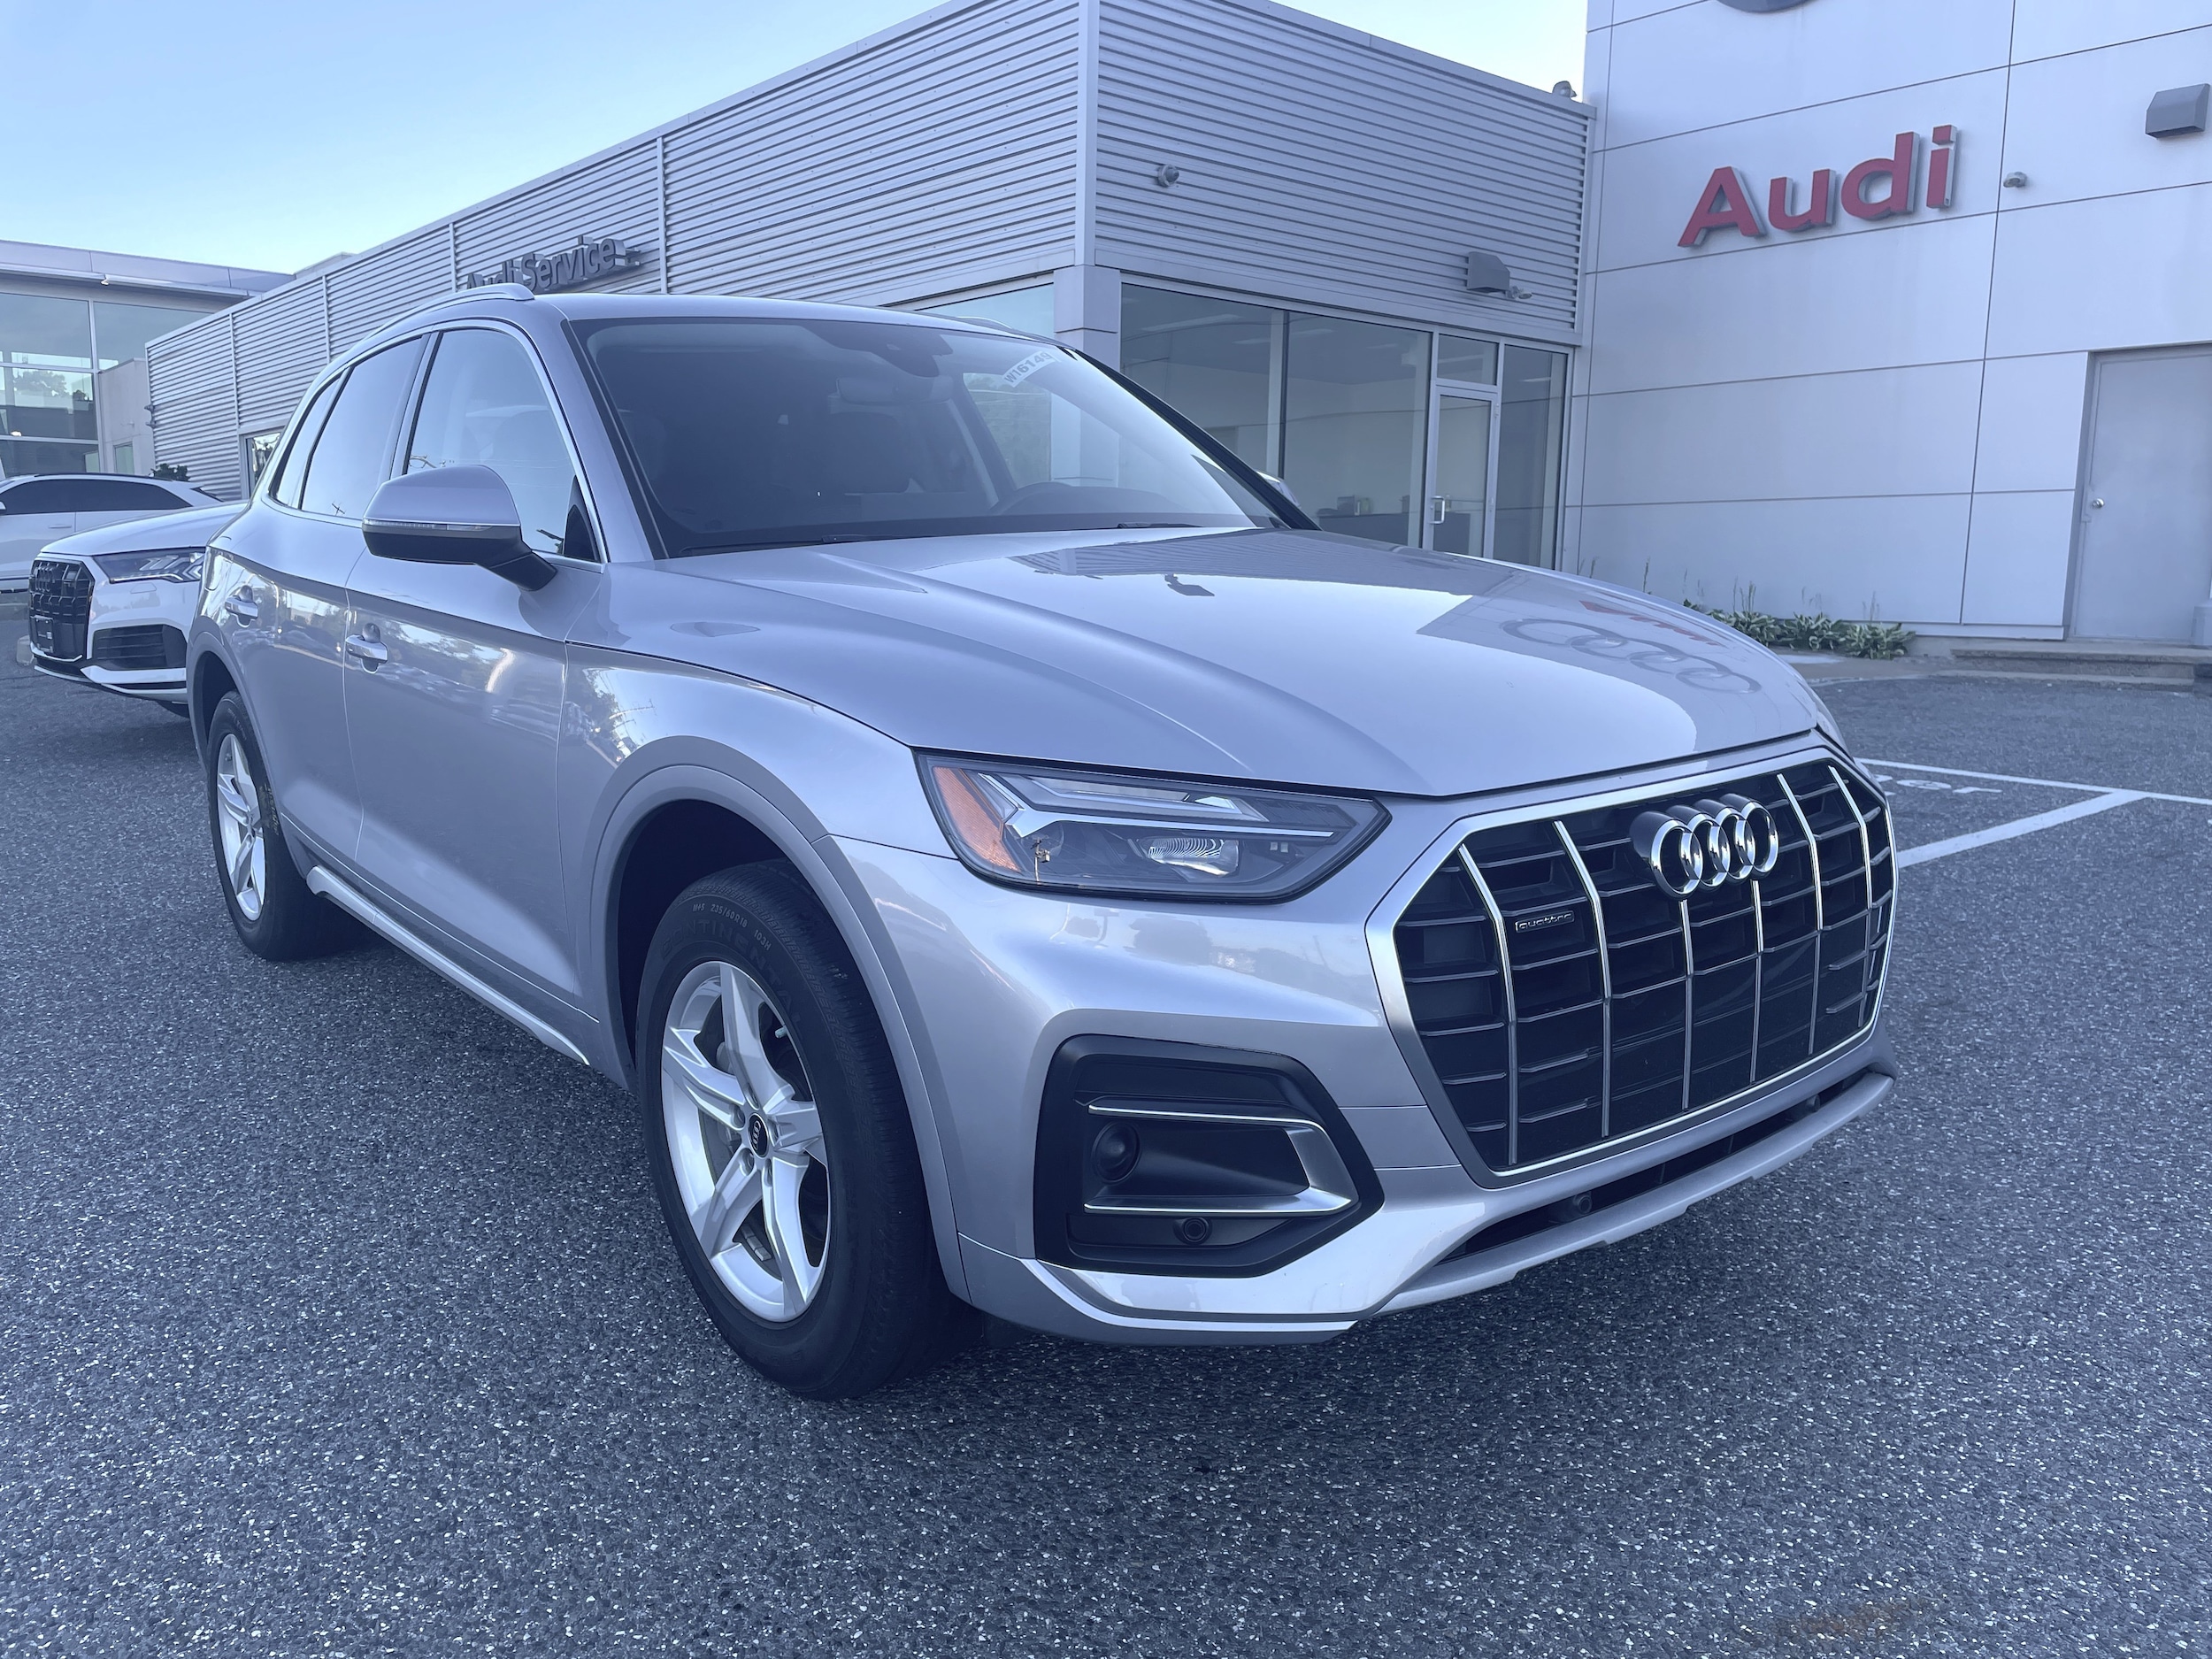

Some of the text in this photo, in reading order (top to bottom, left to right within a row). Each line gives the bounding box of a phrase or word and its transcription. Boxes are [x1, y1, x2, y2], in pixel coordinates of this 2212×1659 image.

[1677, 124, 1956, 248] Audi
[466, 234, 625, 292] di Service
[1003, 351, 1053, 384] W16149
[1518, 912, 1572, 930] quattro
[754, 929, 772, 951] 103H
